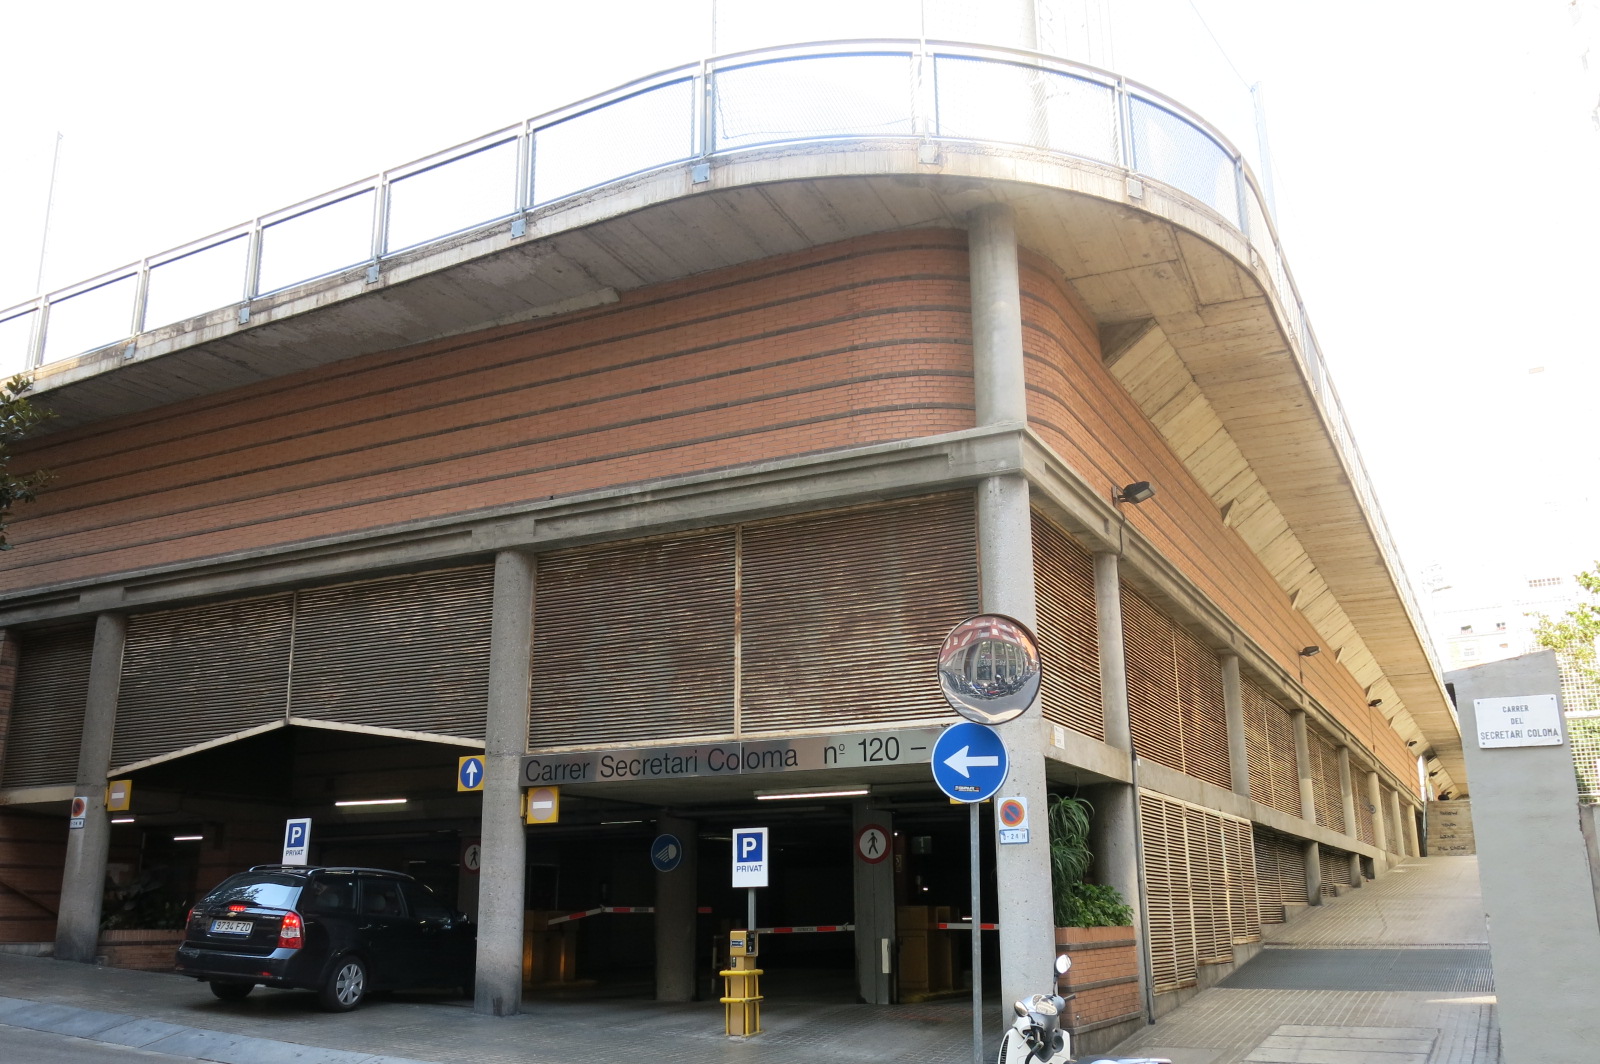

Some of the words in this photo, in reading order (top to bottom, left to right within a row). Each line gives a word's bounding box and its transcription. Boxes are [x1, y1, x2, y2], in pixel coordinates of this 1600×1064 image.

[1503, 705, 1529, 713] CARRER
[1481, 730, 1523, 740] SECRETARI
[1528, 728, 1559, 738] COLOMA
[525, 760, 590, 782] Carrer
[600, 750, 698, 778] Secretari
[708, 748, 798, 772] Coloma
[858, 736, 900, 762] 120
[291, 826, 301, 844] P
[743, 838, 757, 858] P
[216, 921, 234, 930] 9734
[235, 922, 251, 932] FZD
